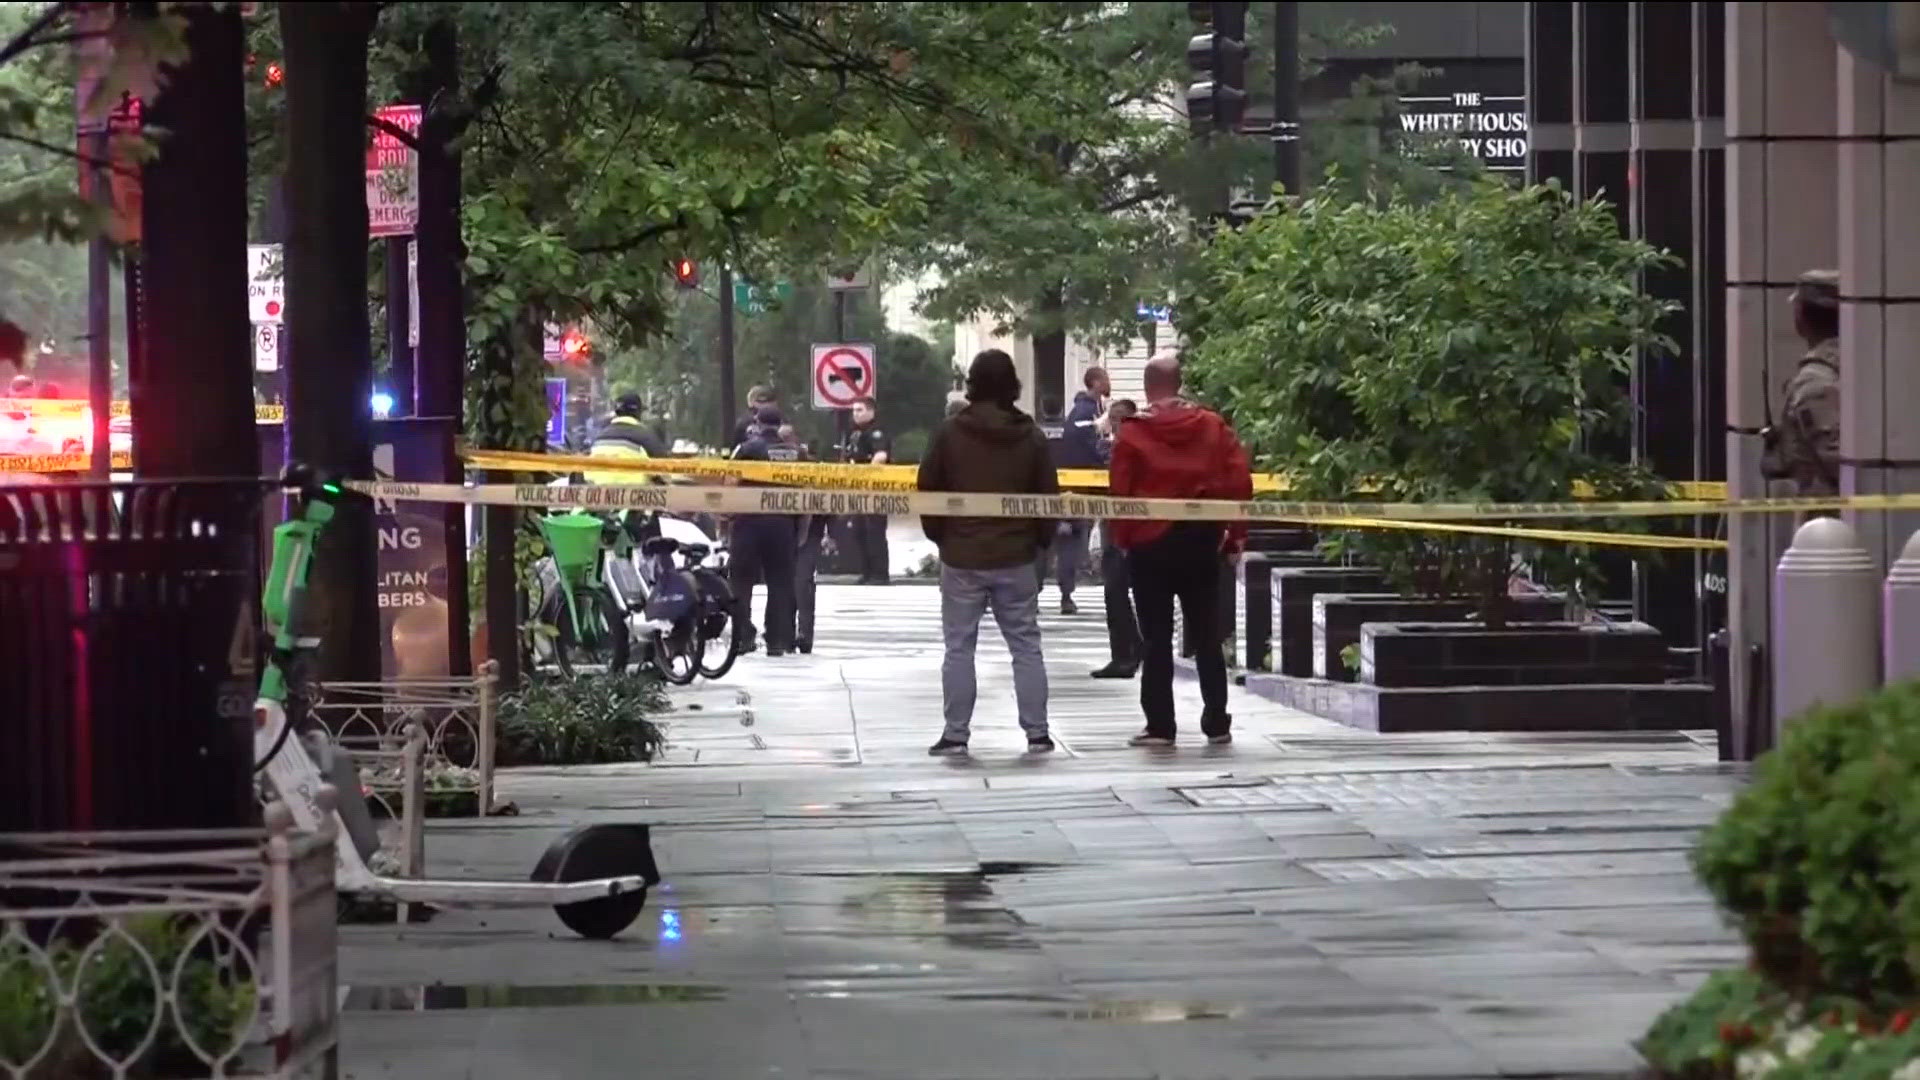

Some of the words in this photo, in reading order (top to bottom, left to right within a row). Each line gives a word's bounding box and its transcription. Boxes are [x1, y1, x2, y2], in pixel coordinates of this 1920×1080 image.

[1453, 92, 1481, 106] THE
[1400, 113, 1464, 131] WHITE
[772, 472, 817, 484] POLICE
[820, 476, 848, 486] LINE
[515, 486, 554, 500] POLICE
[558, 486, 582, 502] LINE
[586, 487, 601, 503] DO
[605, 488, 625, 505] NOT
[629, 488, 668, 507] CROSS
[760, 491, 800, 511] POLICE
[803, 492, 827, 511] LINE
[830, 493, 846, 513] DO
[848, 494, 868, 513] NOT
[873, 494, 910, 515] CROSS
[1001, 497, 1038, 515] POLICE
[1070, 499, 1085, 515] DO
[1087, 499, 1109, 516] NOT
[377, 527, 422, 550] NG
[378, 591, 426, 608] BERS
